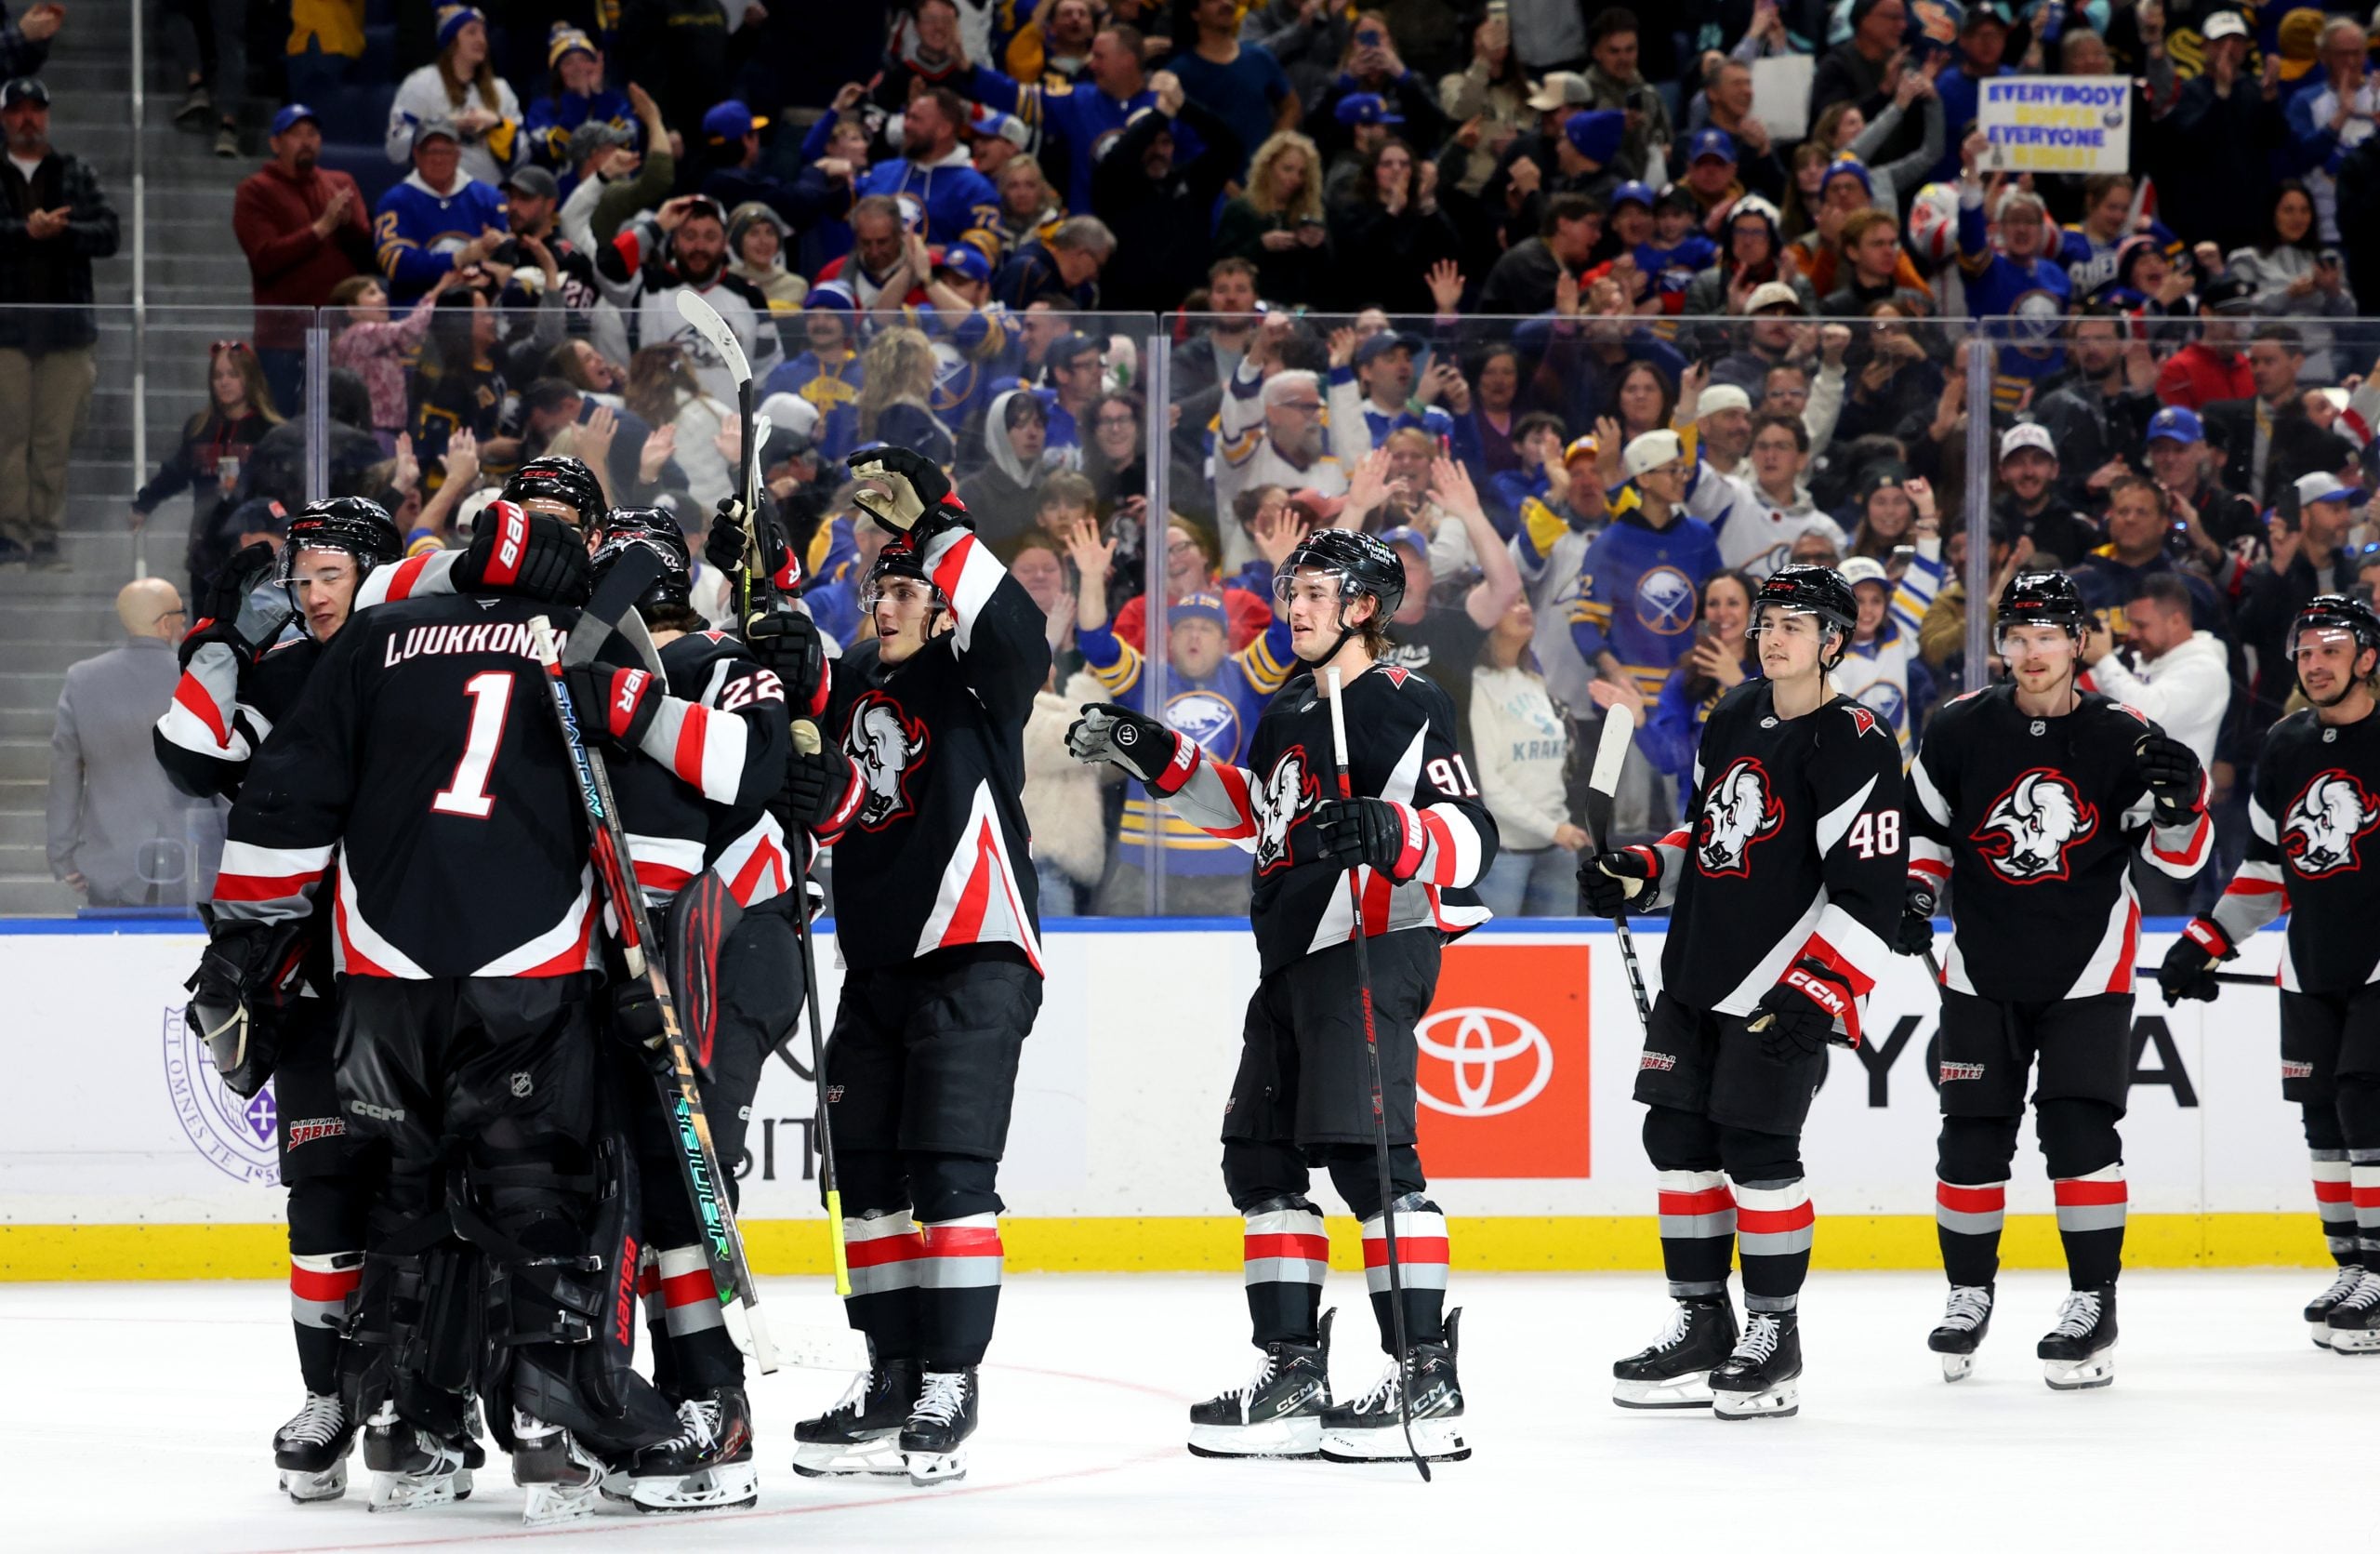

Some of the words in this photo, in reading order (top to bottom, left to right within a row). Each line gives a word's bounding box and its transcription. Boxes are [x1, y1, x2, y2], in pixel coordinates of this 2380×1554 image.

[1989, 84, 2126, 108] EVERYBODY
[1988, 126, 2105, 147] EVERYONE
[522, 470, 559, 478] CCM
[1768, 582, 1796, 591] CCM
[721, 669, 786, 713] 22
[430, 670, 516, 820] 1
[550, 680, 604, 819] SHADOW
[1425, 751, 1480, 798] 91
[1847, 809, 1901, 860] 48
[1617, 925, 1652, 1024] CCM
[1787, 970, 1845, 1015] CCM
[166, 1016, 181, 1049] UT
[168, 1058, 208, 1139] OMNES
[350, 1099, 405, 1122] CCM
[286, 1123, 347, 1153] SABRE
[290, 1116, 345, 1129] BUFFAL
[207, 1141, 232, 1169] TE
[668, 1089, 732, 1262] BAUER
[615, 1235, 638, 1348] BAUER
[1275, 1381, 1315, 1414] CCM
[712, 1428, 744, 1465] CCM
